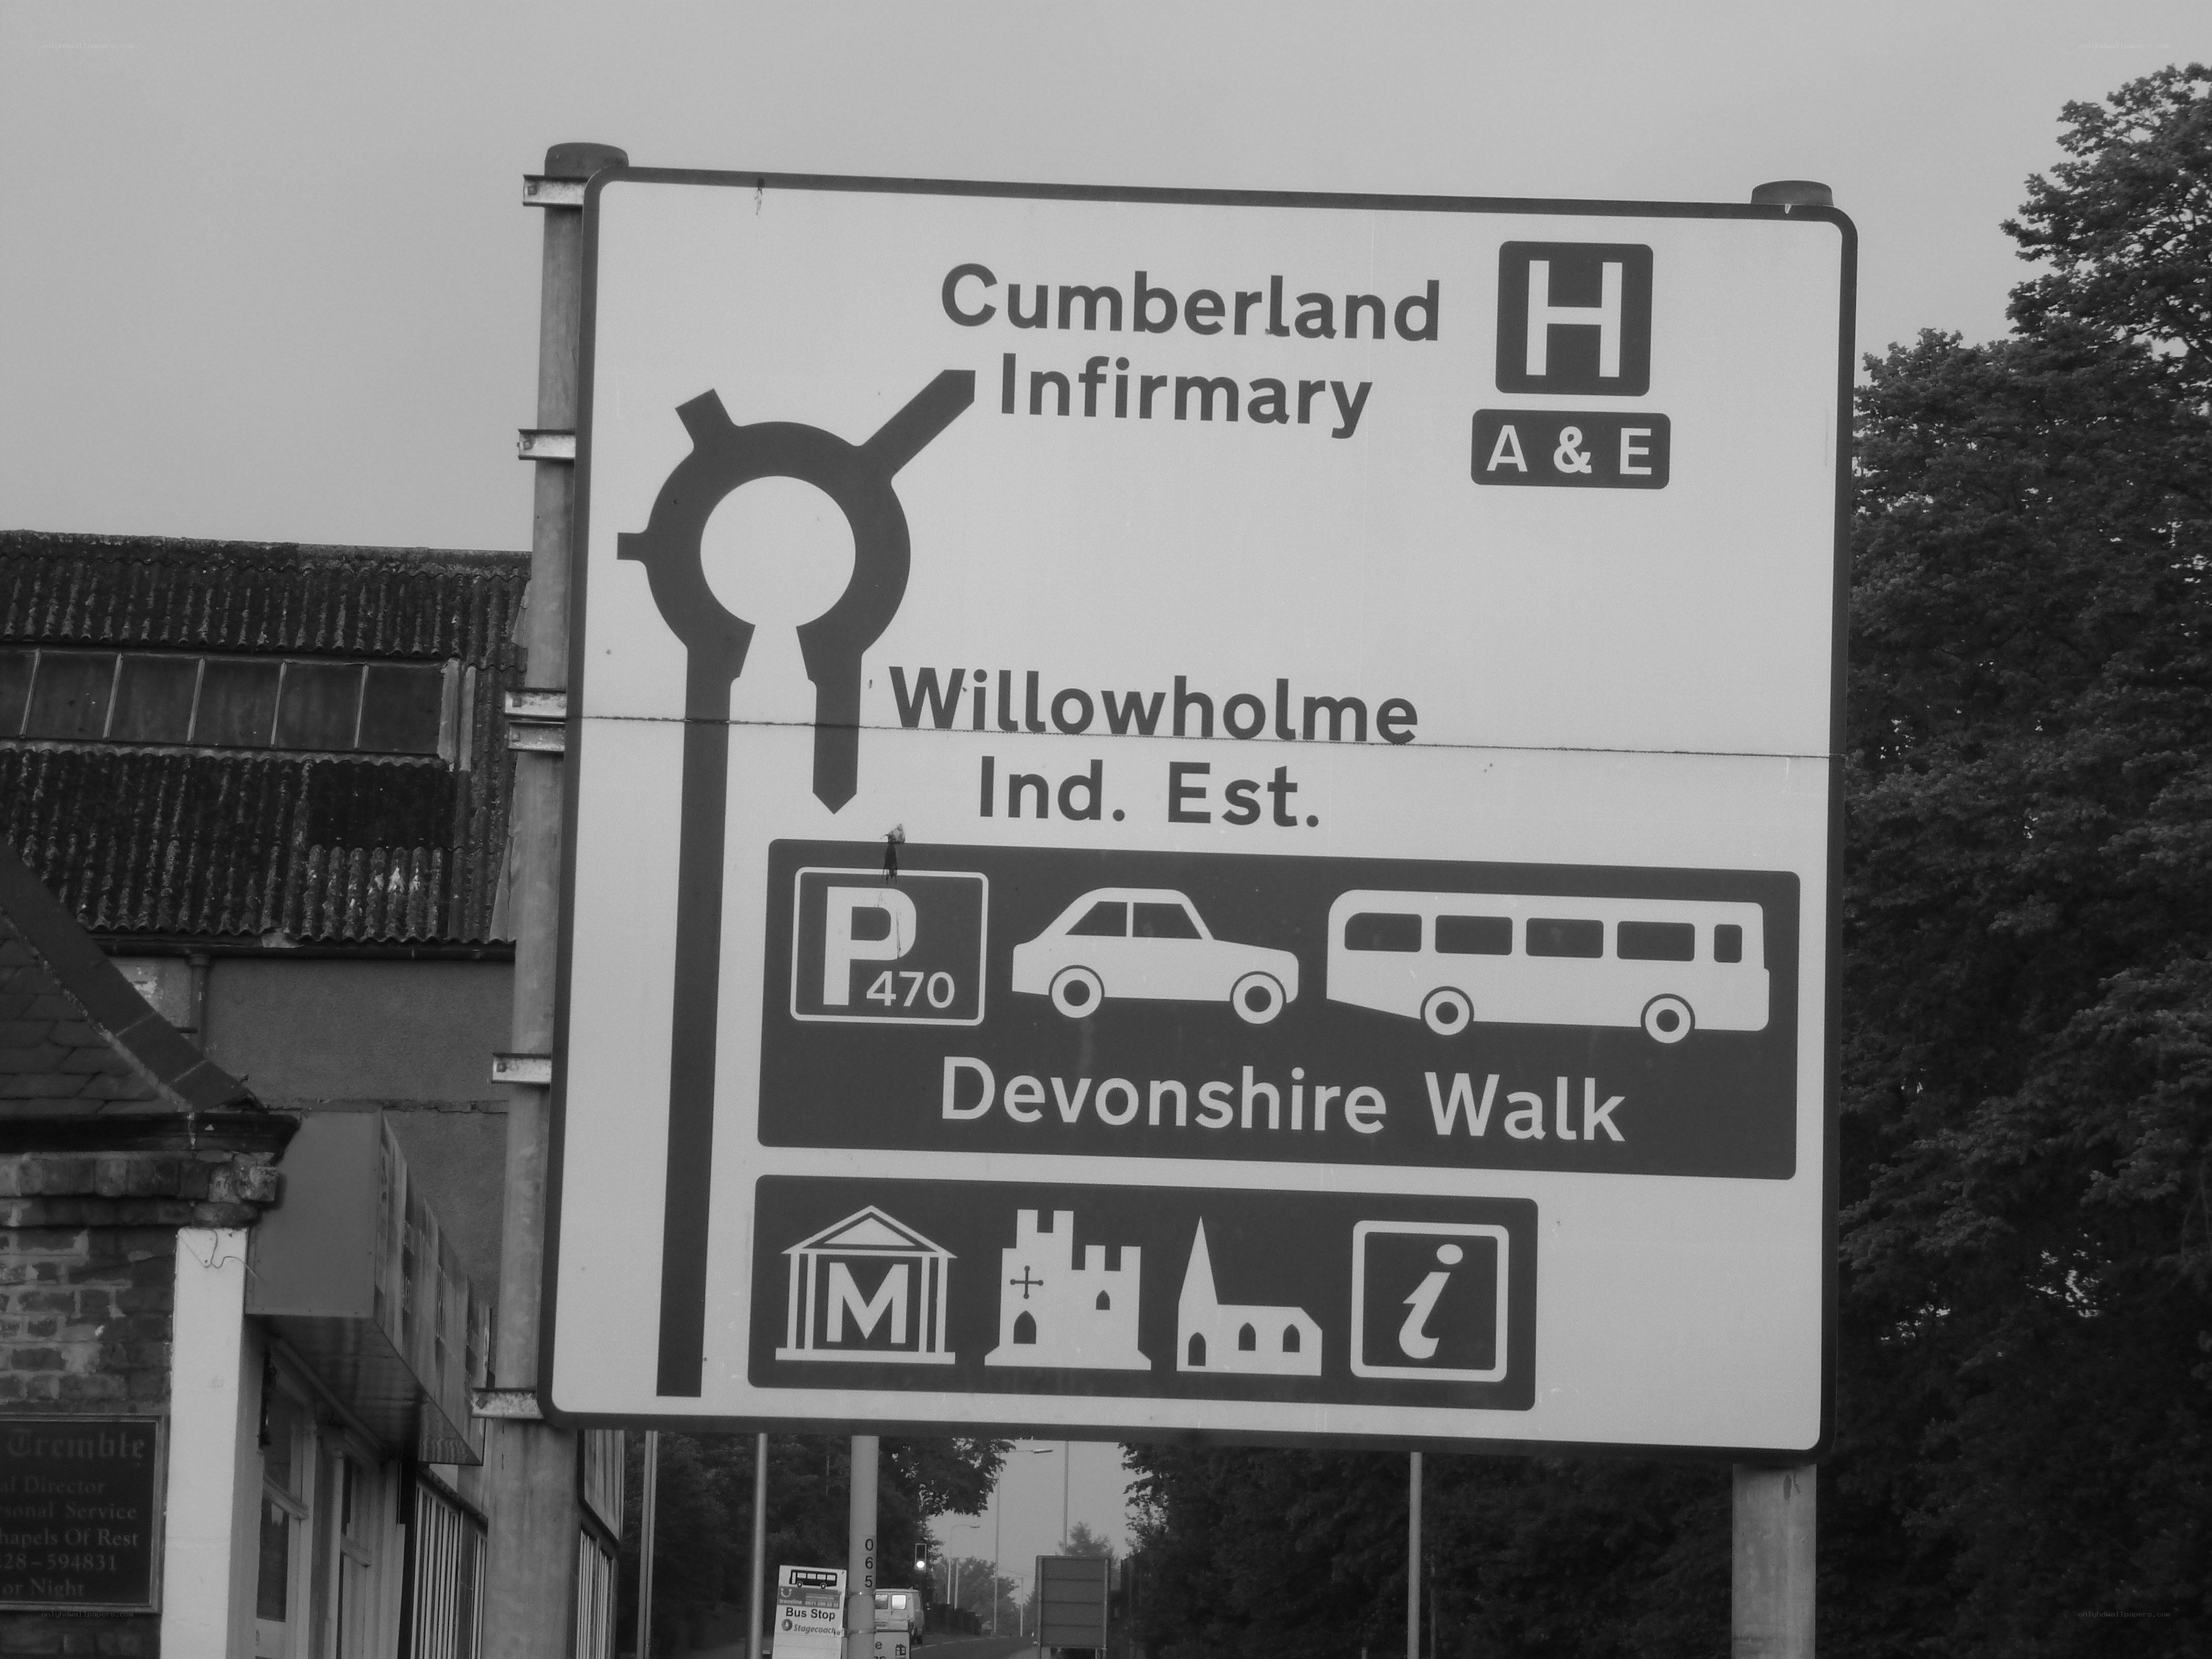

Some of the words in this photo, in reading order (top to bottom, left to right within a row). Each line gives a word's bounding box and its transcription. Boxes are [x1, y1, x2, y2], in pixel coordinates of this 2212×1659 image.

[942, 263, 1440, 342] Cumberland
[1526, 260, 1623, 377] H
[1001, 353, 1373, 439] Infirmary
[1486, 424, 1528, 472] A
[1553, 426, 1592, 474] &
[1620, 428, 1652, 475] E
[889, 666, 1418, 745] Willowholme
[980, 755, 1125, 822] Ind.
[1168, 761, 1319, 827] Est.
[823, 886, 917, 1006] P
[866, 970, 955, 1008] 470
[942, 1056, 1387, 1134] Devonshire
[1424, 1072, 1626, 1141] Walk
[7, 1428, 144, 1459] Tremble
[26, 1475, 106, 1494] Director
[0, 1500, 54, 1519] sonal
[66, 1501, 137, 1520] Service
[65, 1528, 91, 1546] Of
[97, 1528, 139, 1546] Rest
[3, 1584, 24, 1596] or
[30, 1578, 86, 1598] Night
[785, 1607, 807, 1618] Bus
[811, 1608, 836, 1622] Stop
[794, 1624, 836, 1634] Stagecoach
